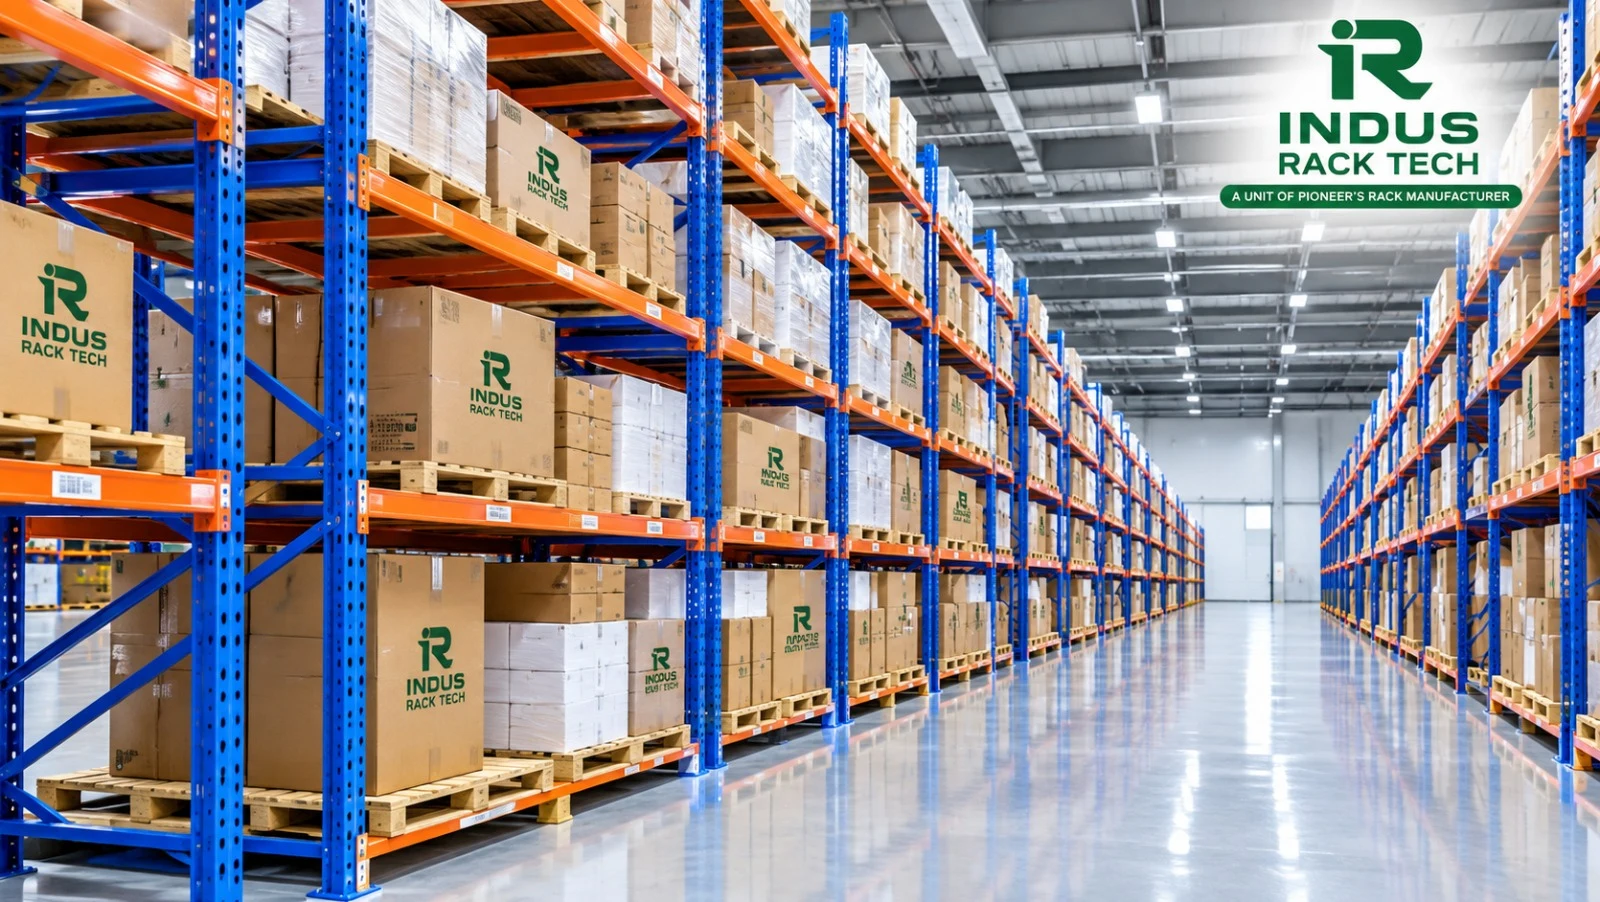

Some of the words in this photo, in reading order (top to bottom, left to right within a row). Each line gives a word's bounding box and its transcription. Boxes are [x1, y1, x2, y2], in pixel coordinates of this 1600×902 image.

[528, 170, 567, 201] INDUS
[22, 316, 107, 351] INDUS
[22, 339, 64, 360] RACK
[69, 348, 107, 367] TECH
[470, 387, 523, 411] INDUS
[470, 403, 496, 417] RACK
[498, 409, 523, 423] TECH
[406, 672, 465, 696] INDUS
[406, 696, 436, 712] RACK
[439, 691, 466, 706] TECH
